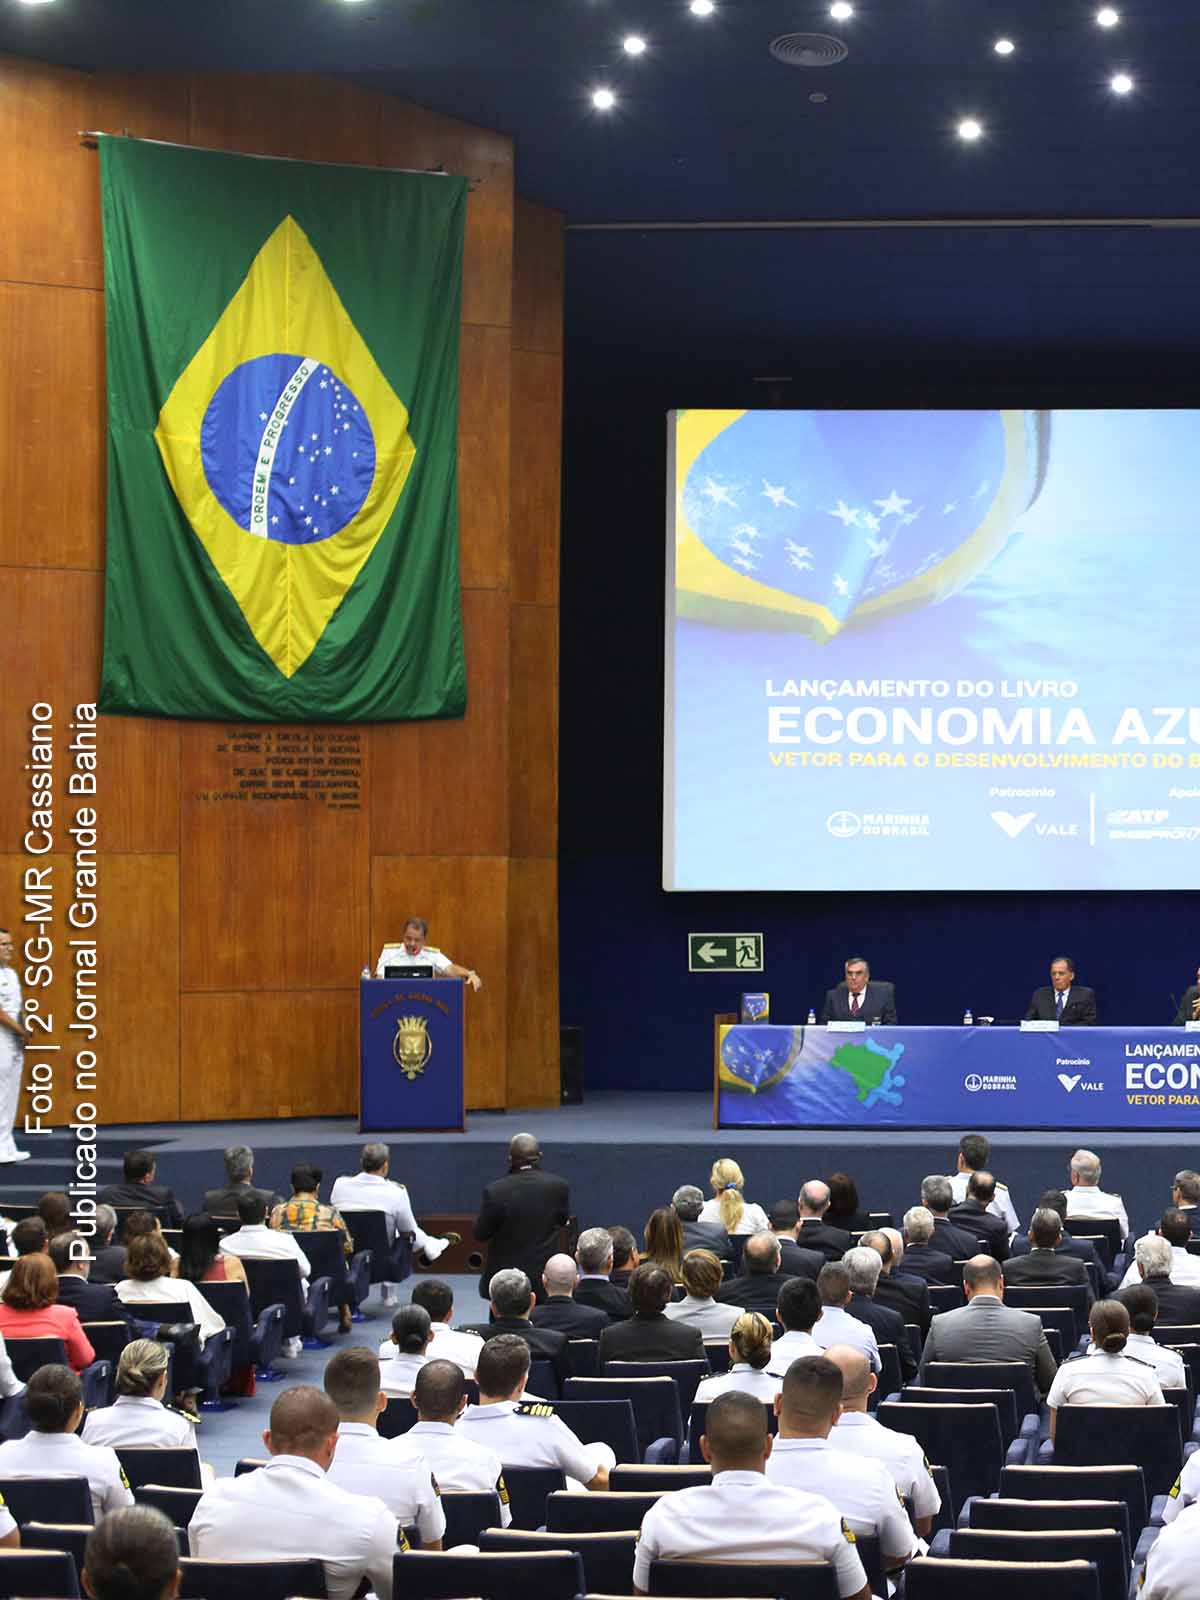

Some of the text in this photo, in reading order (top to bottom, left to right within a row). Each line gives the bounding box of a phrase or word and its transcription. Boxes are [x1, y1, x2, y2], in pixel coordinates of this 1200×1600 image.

[254, 366, 310, 524] ORDEM E PROGRESSO
[765, 679, 1079, 700] LANÇAMENTO DO LIVRO
[767, 706, 1097, 745] ECONOMIA
[768, 752, 843, 768] VETOR
[849, 752, 907, 768] PARA
[912, 752, 930, 768] O
[935, 752, 1147, 768] DESENVOLVIMENTO
[1152, 752, 1184, 768] DO
[1035, 823, 1080, 836] VALE
[982, 1075, 1016, 1083] MARINHA
[1080, 1082, 1105, 1091] VALE
[1127, 1095, 1166, 1105] VETOR
[1168, 1095, 1200, 1105] PARA
